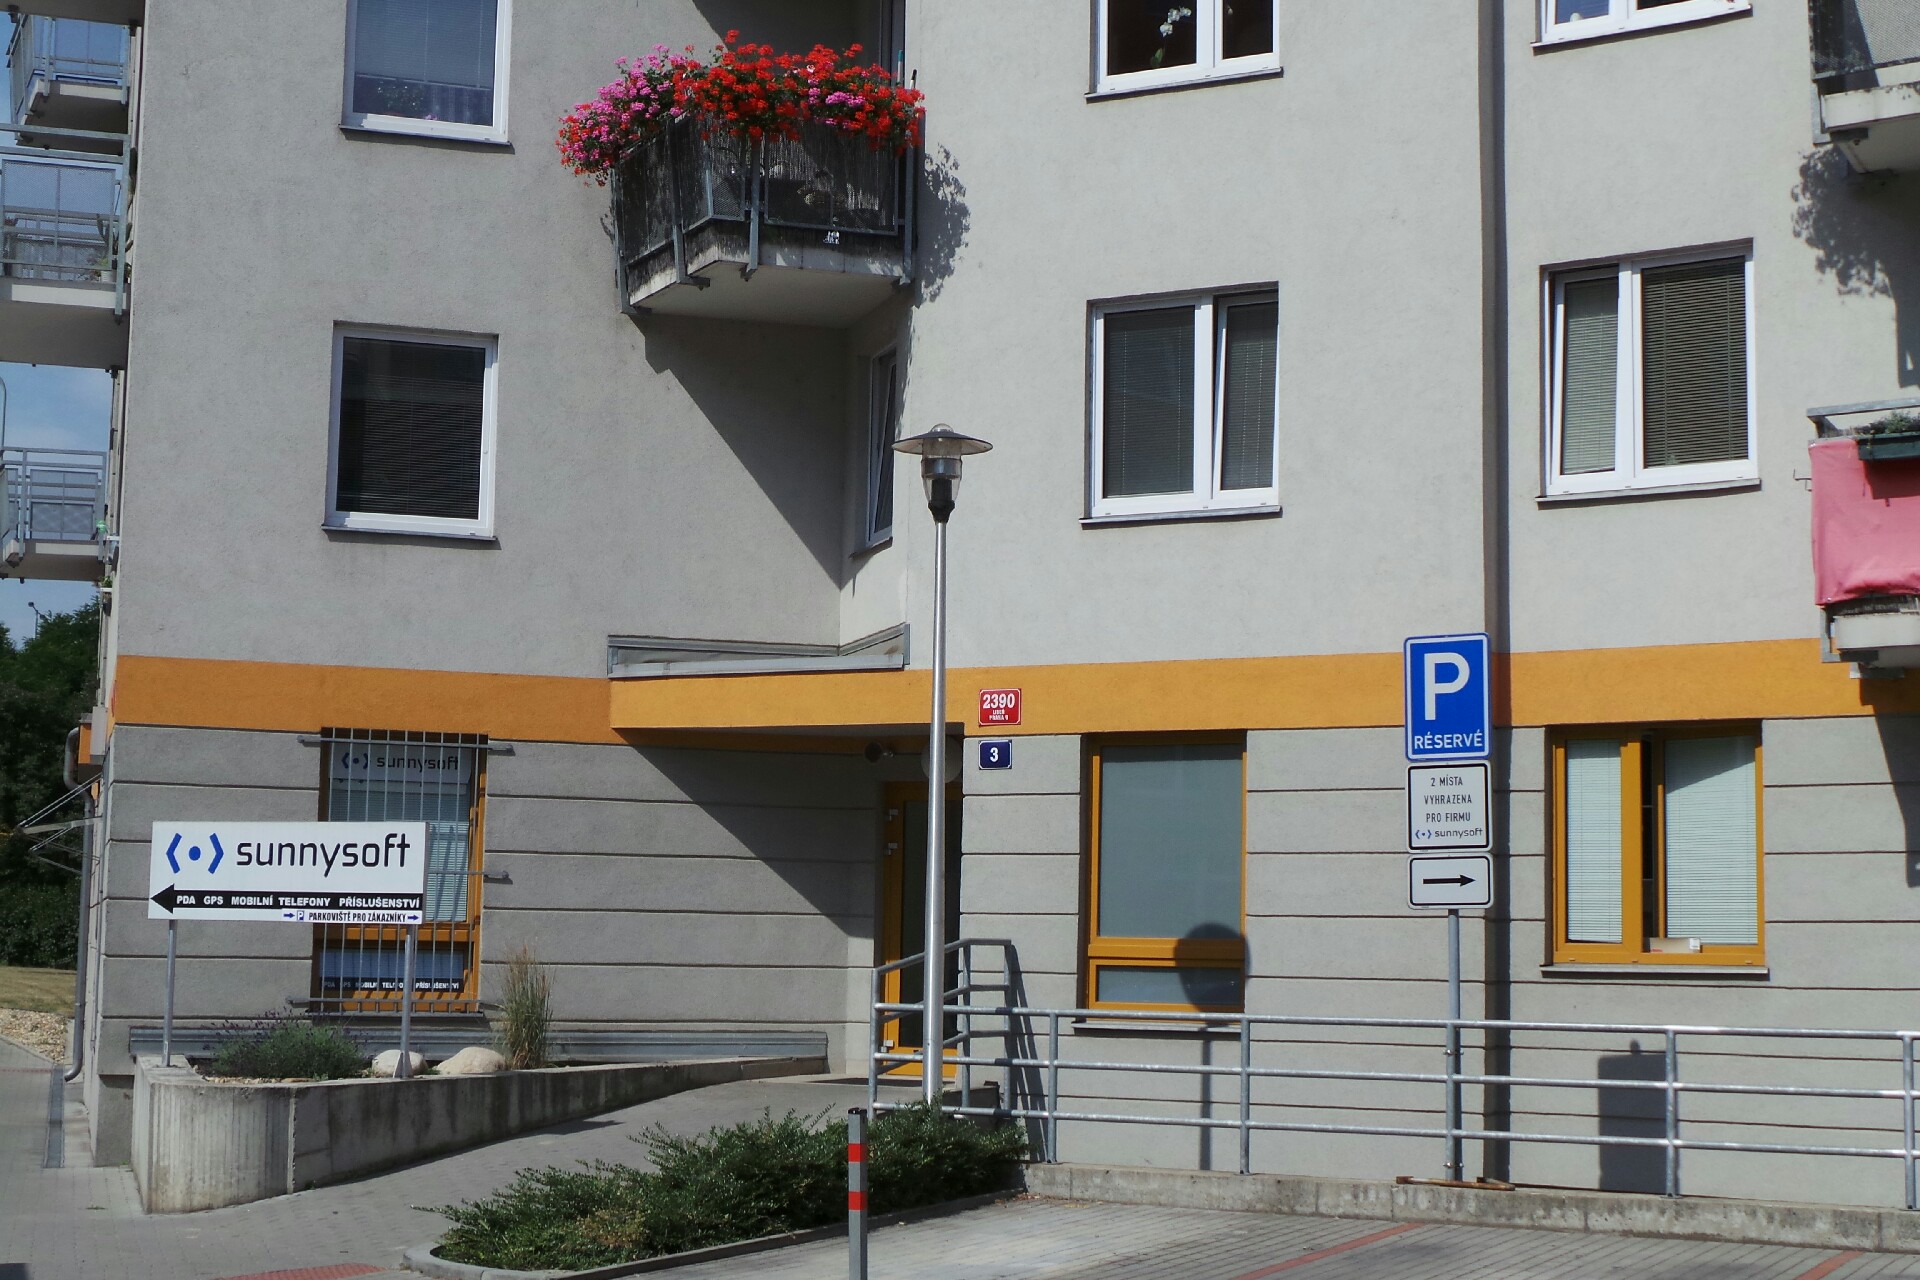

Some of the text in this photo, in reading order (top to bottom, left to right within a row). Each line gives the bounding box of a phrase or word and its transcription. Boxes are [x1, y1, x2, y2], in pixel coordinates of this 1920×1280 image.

[1424, 652, 1470, 721] P
[982, 693, 1015, 709] 2390
[1414, 729, 1483, 750] RÉSERVÉ
[989, 747, 999, 762] 3
[376, 755, 459, 773] sunnysoft
[1430, 774, 1463, 787] 2 MÍSTA
[1423, 794, 1473, 805] VYHRAZENA
[1426, 811, 1471, 823] PRO FIRMU
[1434, 827, 1483, 839] sunnysoft
[236, 833, 411, 877] sunnysoft
[176, 894, 420, 909] PDA GPS MOBILNÍ TELEFONY PŘÍSLUŠENSTVÍ
[308, 911, 351, 922] PARKOVIŠTĚ
[353, 912, 366, 922] PRO
[368, 911, 407, 923] ZÁKAZNÍKY
